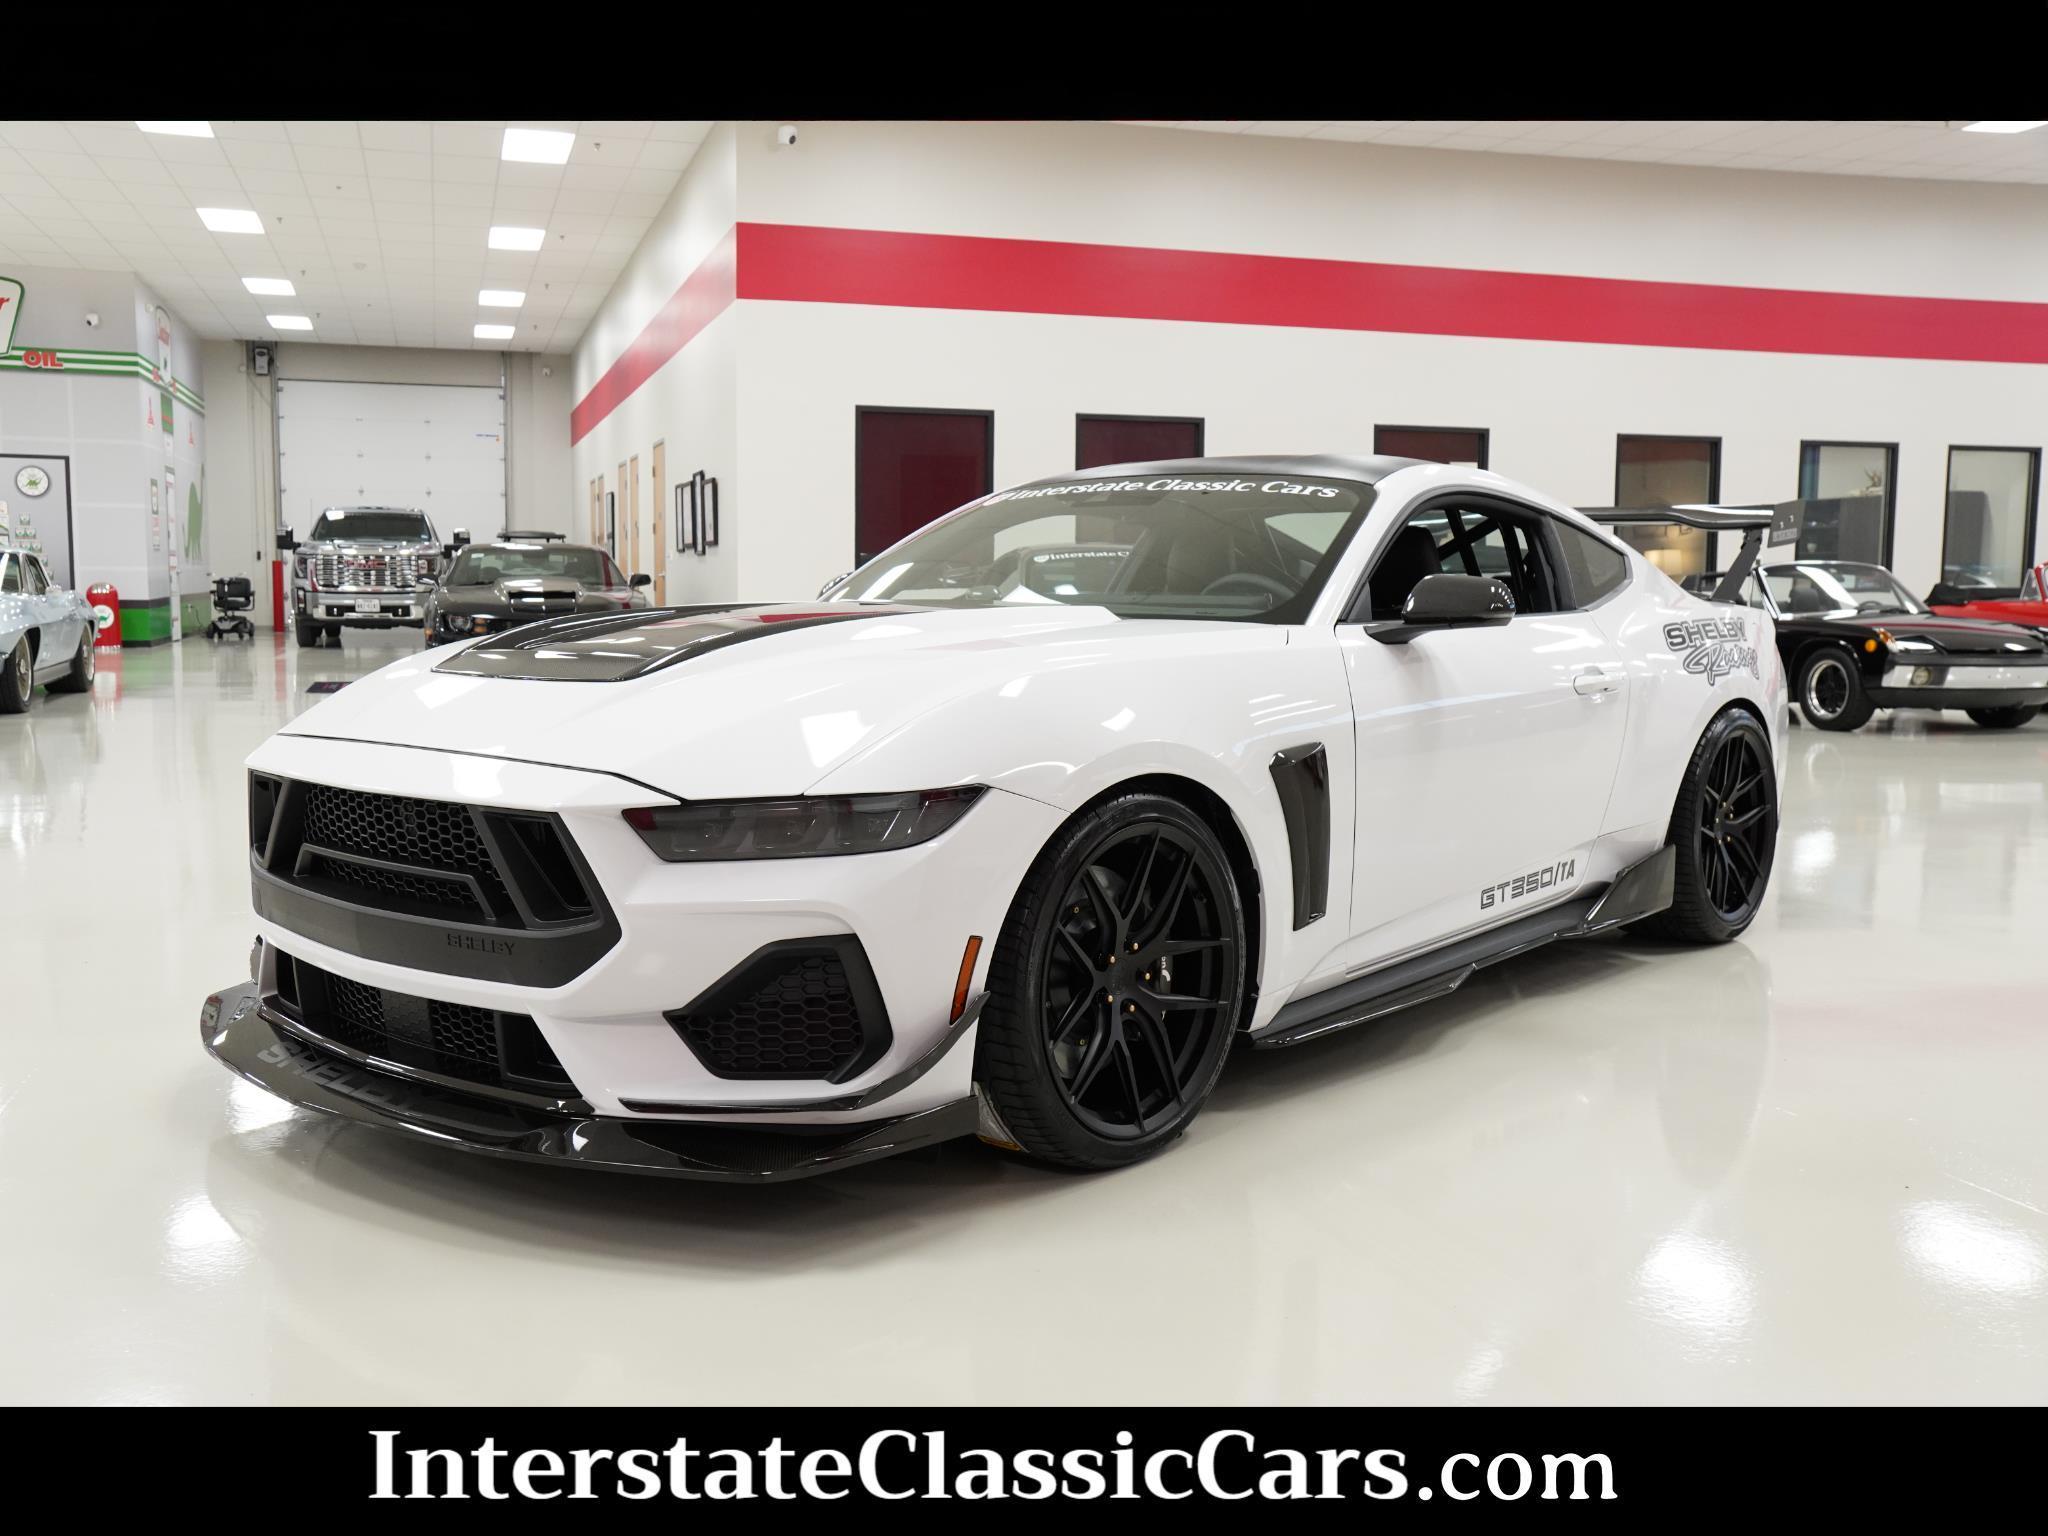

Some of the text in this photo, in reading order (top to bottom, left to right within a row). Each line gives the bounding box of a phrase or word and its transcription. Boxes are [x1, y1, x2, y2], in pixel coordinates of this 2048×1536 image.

[23, 350, 64, 368] OIL
[1007, 478, 1340, 500] Interstate Classic Cars
[1050, 551, 1116, 561] Interstate
[1663, 617, 1748, 652] SHELBY
[1480, 859, 1576, 910] GT350/TA
[447, 933, 516, 956] SHELBY
